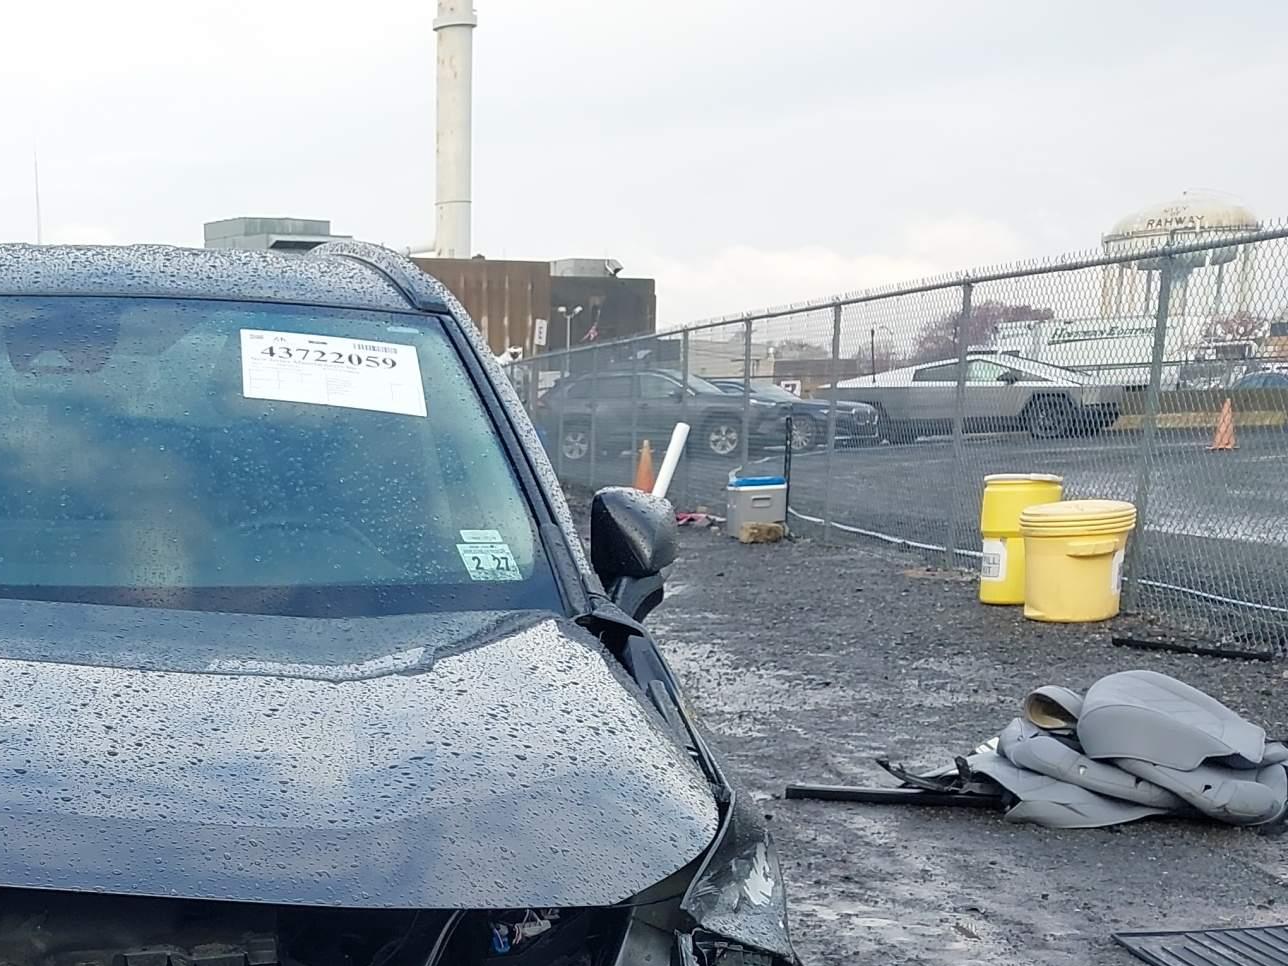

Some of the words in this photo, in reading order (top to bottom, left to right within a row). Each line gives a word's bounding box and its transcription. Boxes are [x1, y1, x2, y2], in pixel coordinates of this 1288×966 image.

[1146, 215, 1205, 230] RAHWAY
[261, 345, 397, 370] 43722059
[472, 556, 485, 571] 2
[492, 554, 511, 572] 27
